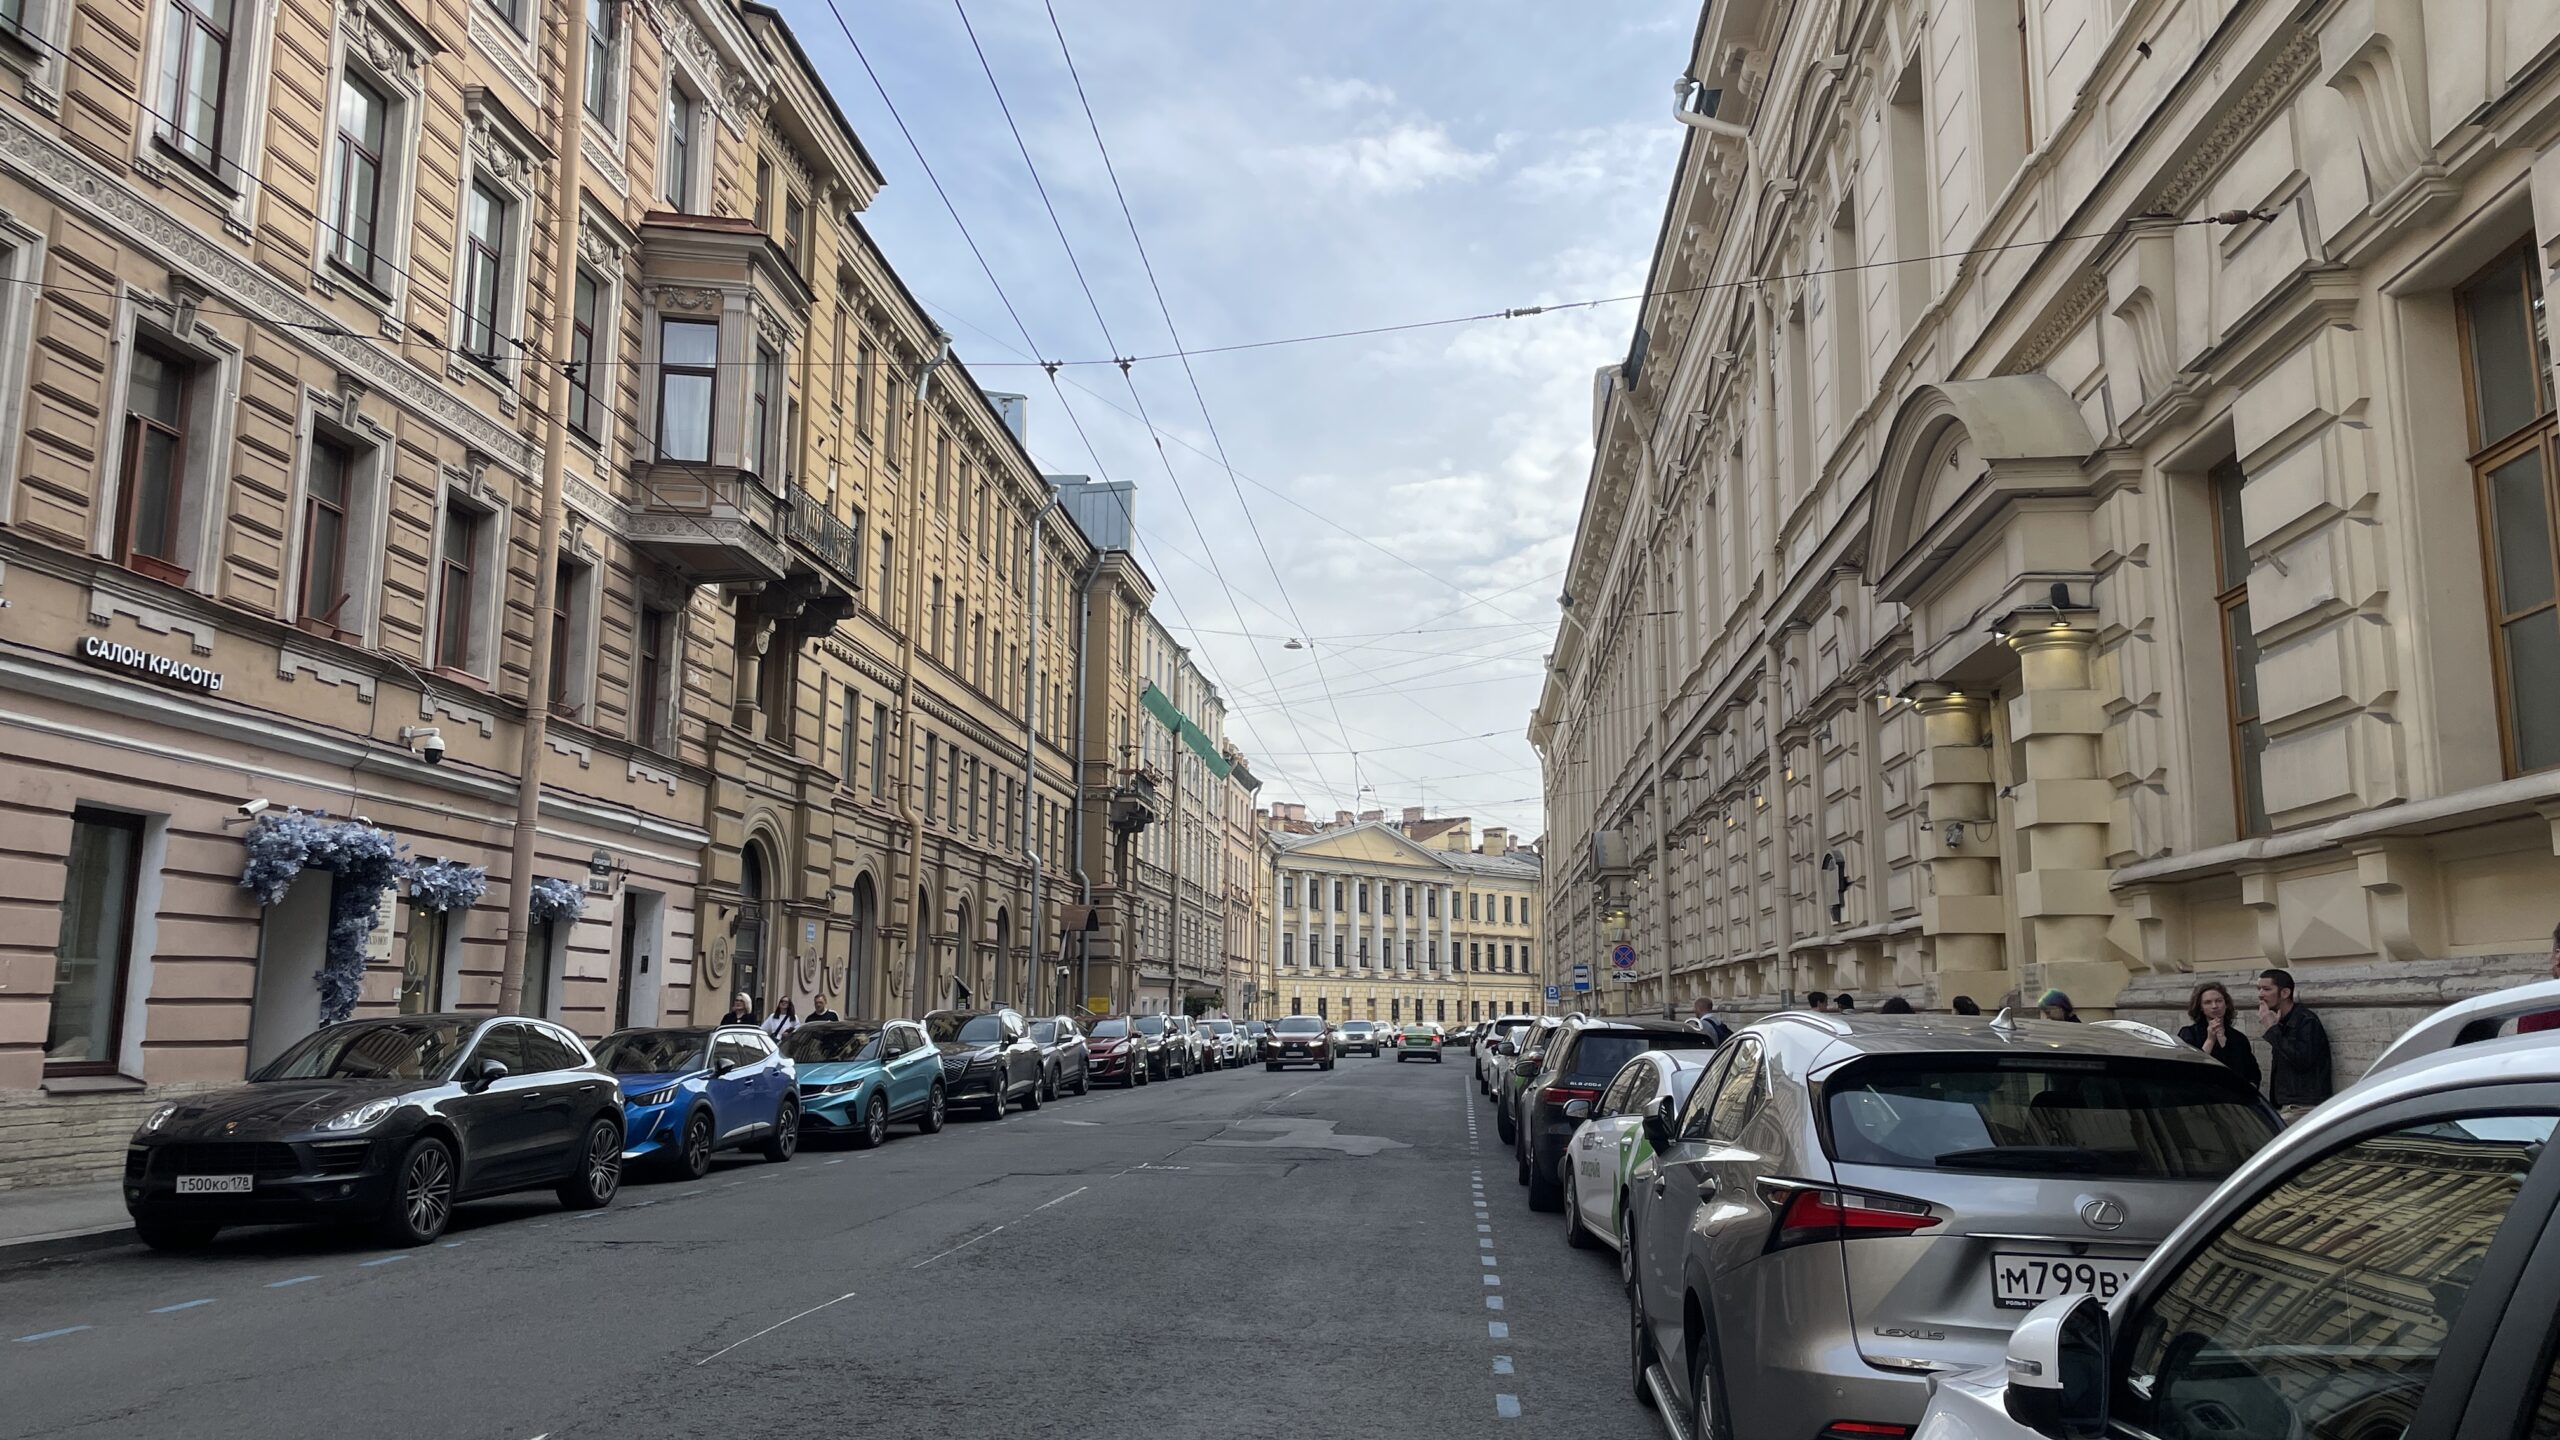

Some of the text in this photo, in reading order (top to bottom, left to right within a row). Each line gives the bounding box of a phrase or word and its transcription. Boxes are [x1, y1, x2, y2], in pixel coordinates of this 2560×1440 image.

[86, 636, 224, 691] САЛОН КРАСОТЫ
[180, 1176, 249, 1191] Т500КО 178
[1873, 1325, 1946, 1341] LEXUS
